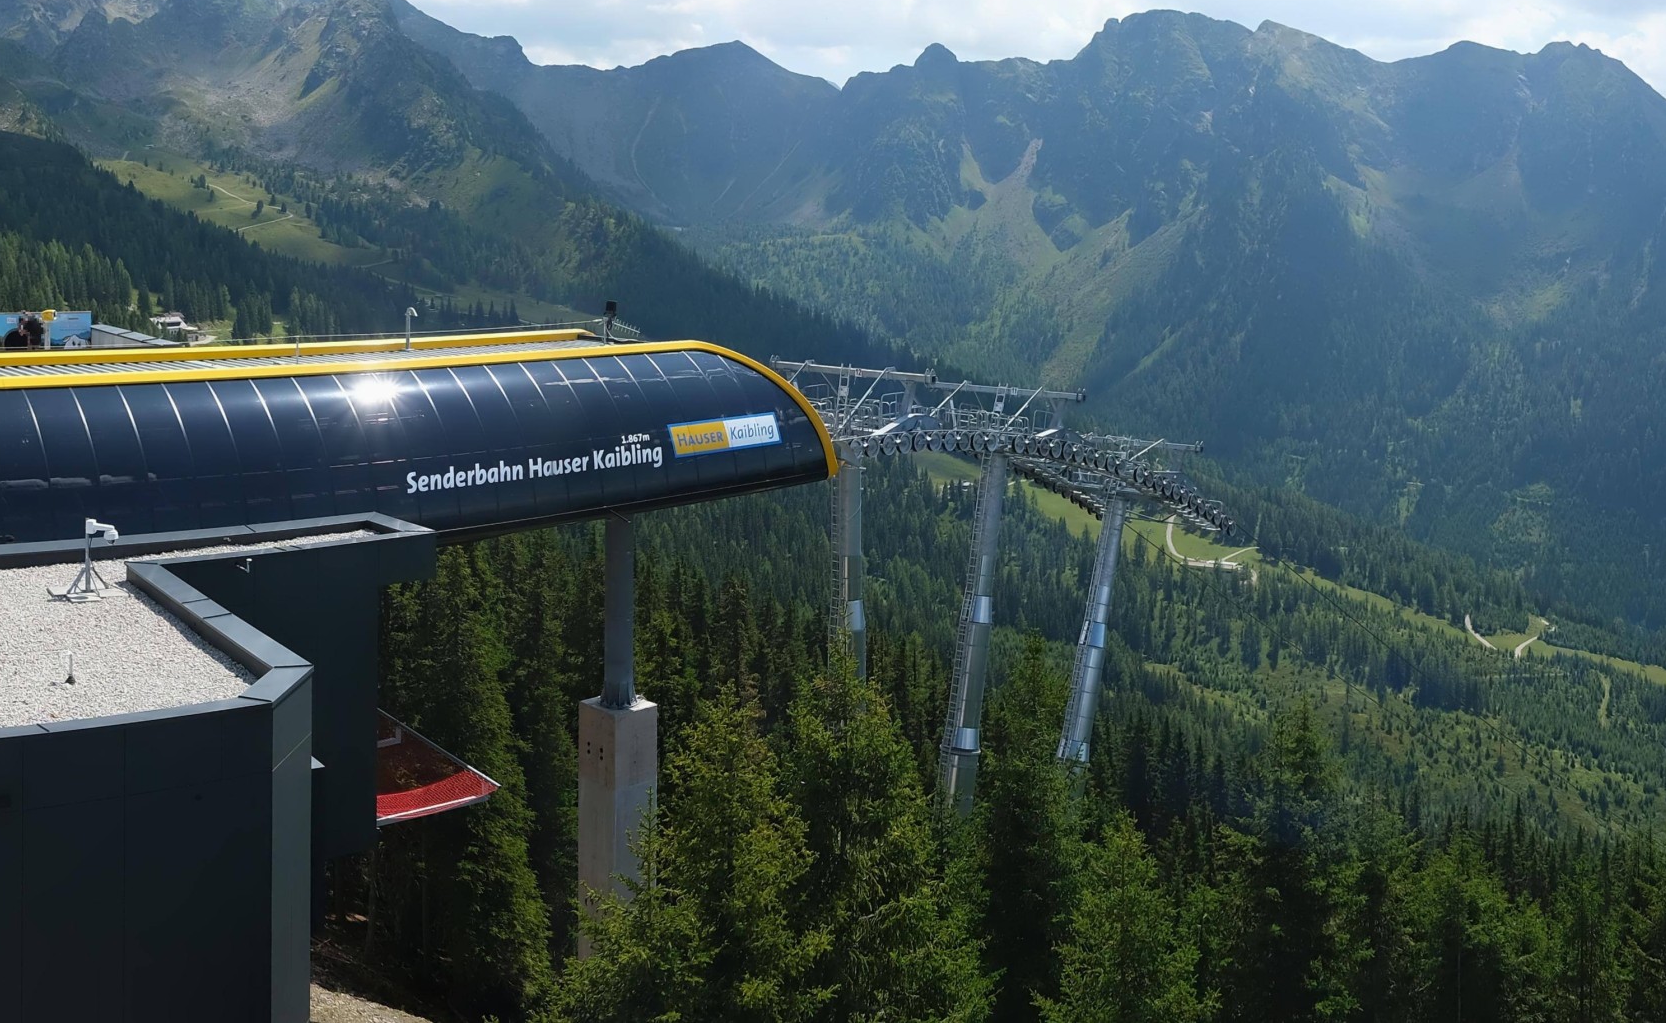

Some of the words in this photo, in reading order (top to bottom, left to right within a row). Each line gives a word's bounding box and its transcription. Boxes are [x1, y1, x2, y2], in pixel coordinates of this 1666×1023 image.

[620, 433, 650, 444] 1.867m
[677, 430, 724, 447] HAUSER
[729, 423, 775, 441] Kaibling
[406, 460, 524, 494] Senderbahn
[528, 454, 589, 480] Hauser
[593, 444, 663, 471] Kaibling
